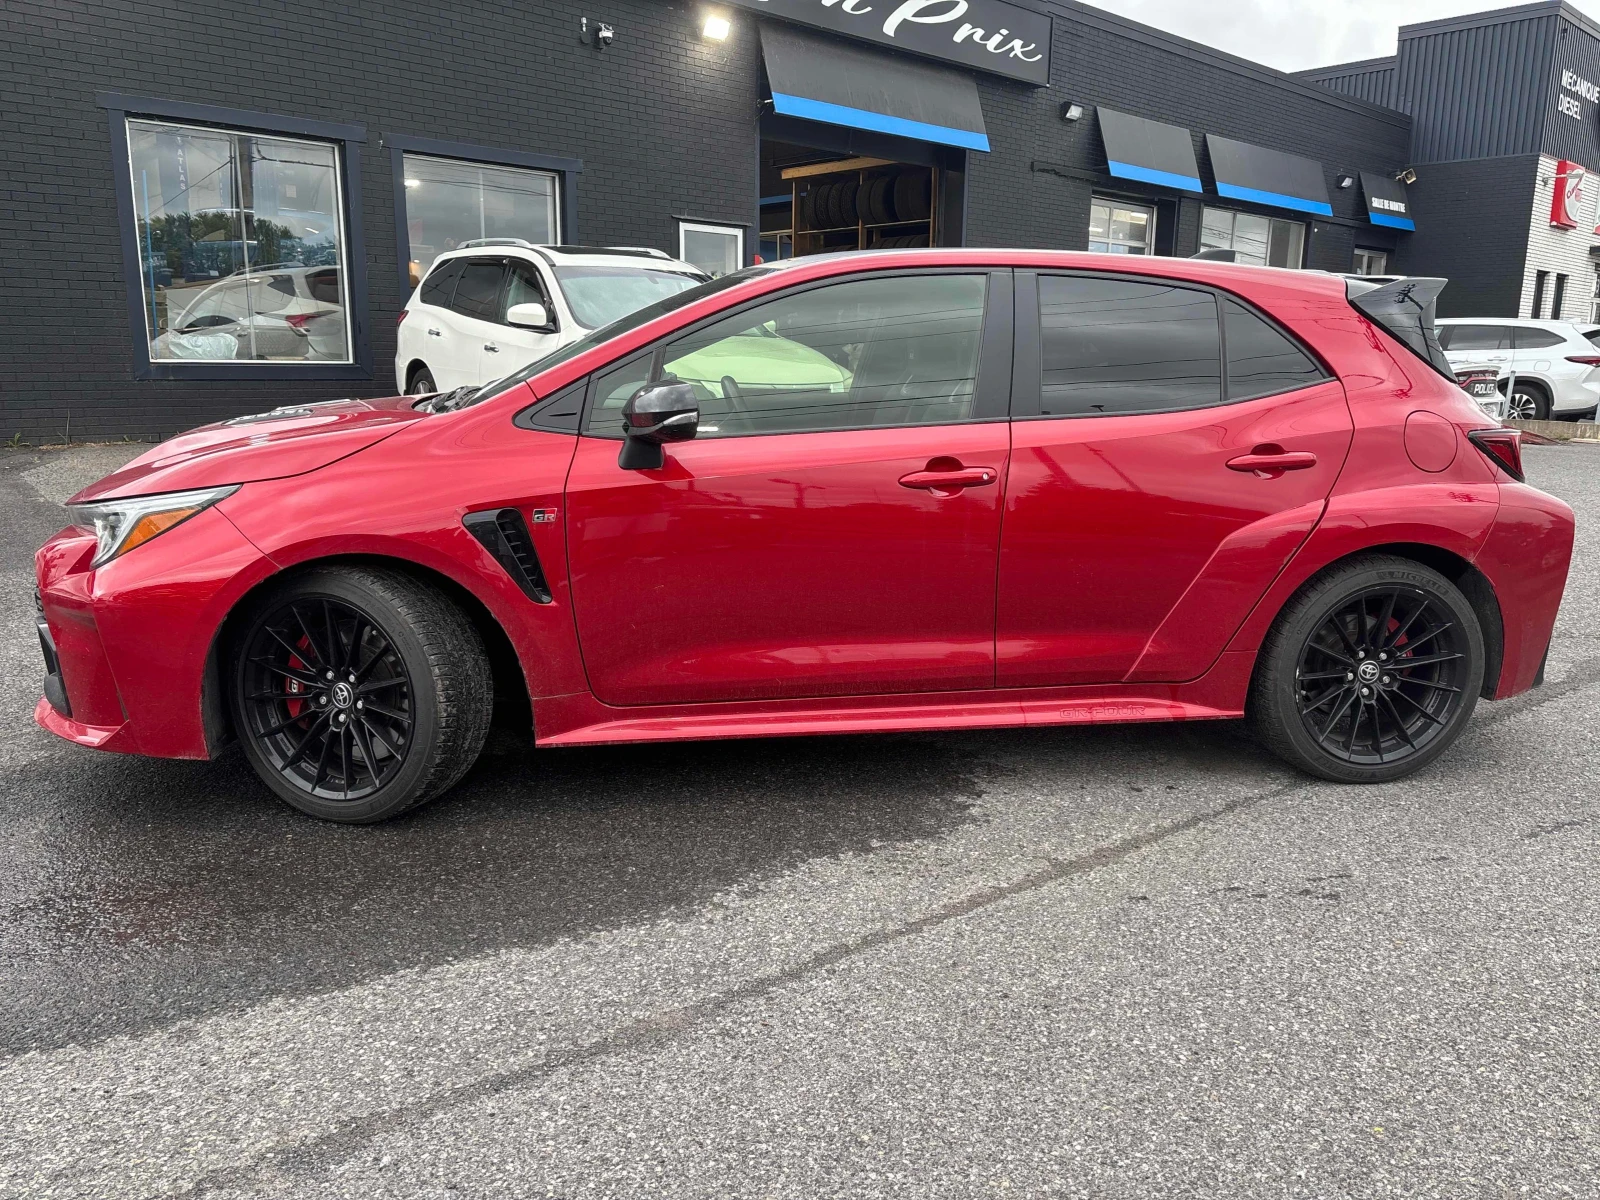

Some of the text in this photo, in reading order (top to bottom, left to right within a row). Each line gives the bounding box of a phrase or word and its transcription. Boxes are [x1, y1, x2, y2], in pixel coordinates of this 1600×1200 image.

[882, 0, 1043, 61] Prix
[1558, 94, 1581, 120] DIESEL
[177, 149, 186, 190] ATLAS
[1473, 383, 1495, 394] POLICE
